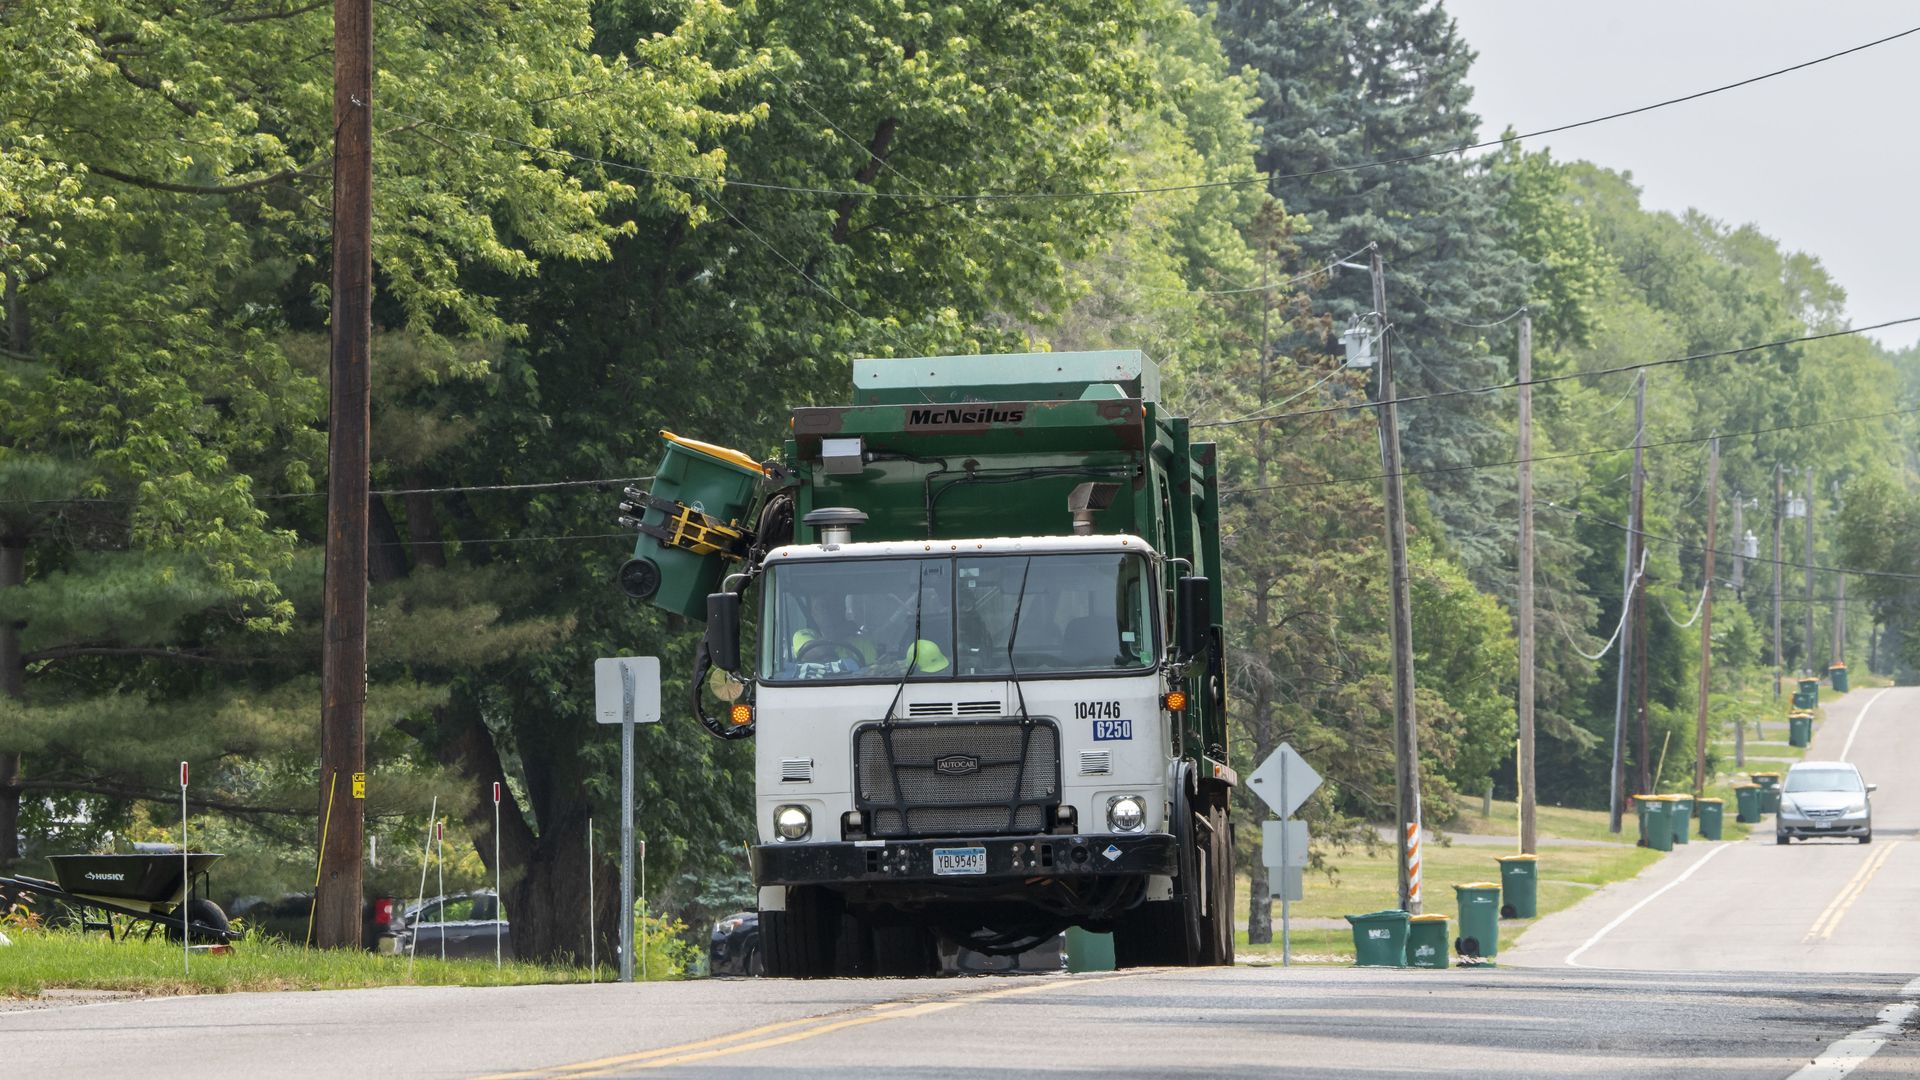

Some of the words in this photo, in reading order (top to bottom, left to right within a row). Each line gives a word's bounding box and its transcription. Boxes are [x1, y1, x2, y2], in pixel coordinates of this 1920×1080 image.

[909, 408, 1024, 425] McNeilus
[1074, 701, 1121, 719] 104746
[1097, 721, 1131, 739] 6250
[940, 761, 976, 769] AUTOCAR
[938, 855, 977, 869] YBL9549
[95, 873, 125, 881] HUSKY
